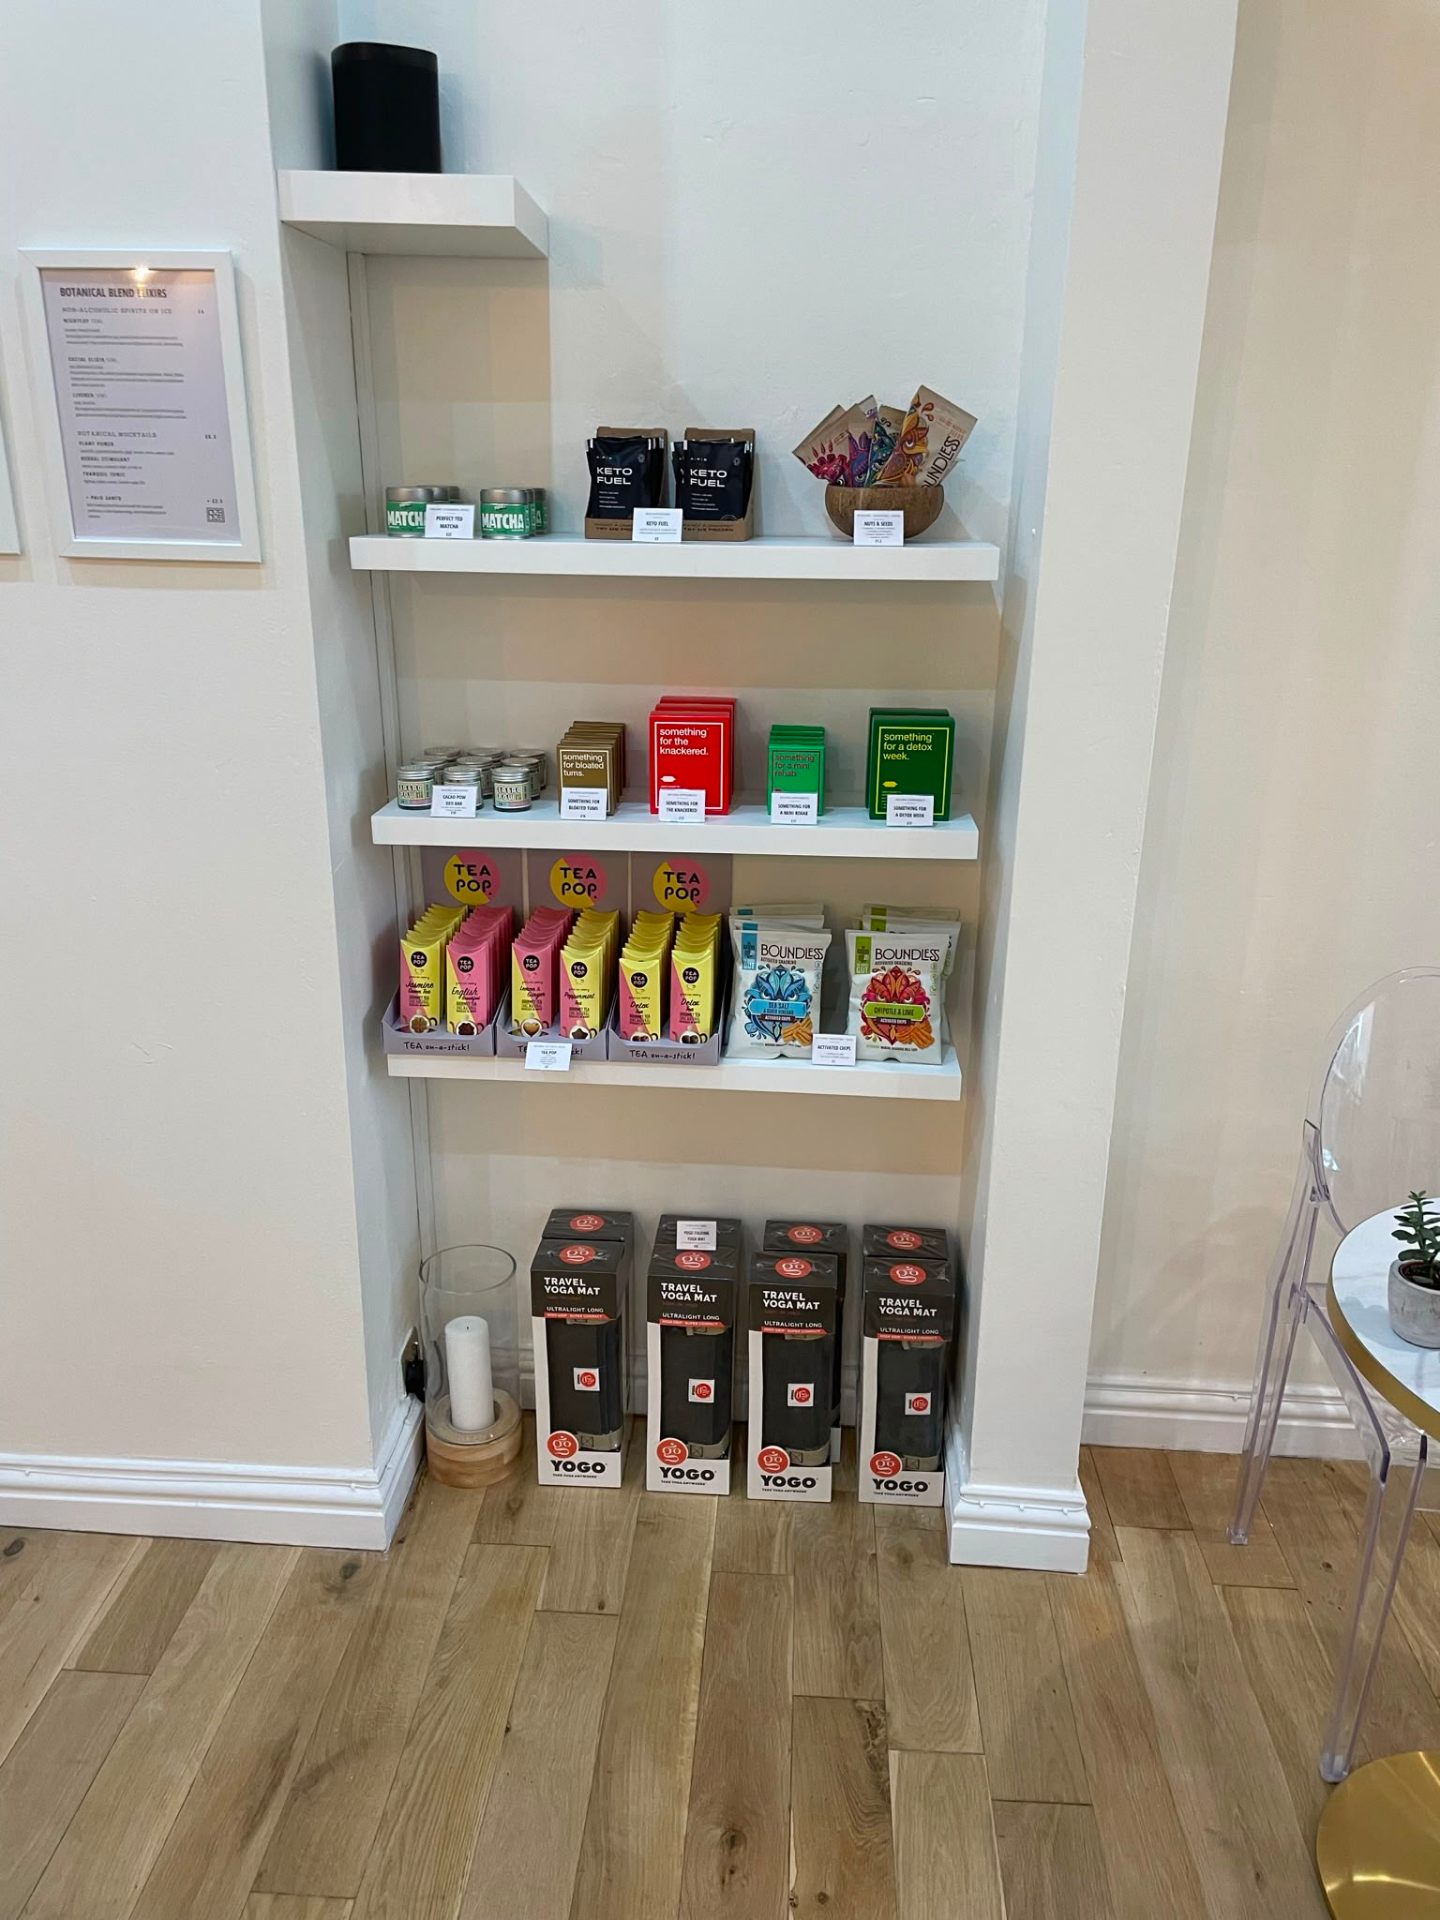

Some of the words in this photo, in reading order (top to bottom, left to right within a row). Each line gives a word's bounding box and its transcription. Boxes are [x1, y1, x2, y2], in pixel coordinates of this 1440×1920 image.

[60, 287, 106, 298] BOTANICAL
[108, 288, 135, 298] BLEND
[921, 436, 961, 488] UNDLESS
[596, 467, 633, 476] KETO
[690, 468, 727, 478] KETO
[596, 476, 631, 485] FUEL
[690, 478, 725, 488] FUEL
[387, 511, 426, 526] MATCH
[482, 513, 524, 529] MATCHA
[660, 728, 706, 738] something
[884, 732, 932, 742] something
[659, 737, 671, 746] for
[674, 738, 689, 746] the
[883, 742, 896, 751] for
[906, 742, 933, 751] detox
[660, 746, 709, 756] knackered.
[883, 752, 910, 760] week.
[563, 753, 603, 763] something
[562, 761, 574, 769] for
[575, 761, 605, 770] bloated
[563, 769, 585, 777] tums.
[453, 864, 491, 876] TEA
[560, 867, 597, 879] TEA
[663, 871, 700, 884] TEA
[760, 943, 824, 960] BOUNDLESS
[875, 948, 940, 962] BOUNDLESS
[451, 986, 478, 1000] English
[404, 1041, 422, 1050] TEA
[425, 1042, 470, 1051] on-a-stick!
[629, 1050, 648, 1058] TEA
[651, 1051, 696, 1060] on-a-stick!
[544, 1277, 586, 1287] TRAVEL
[544, 1286, 574, 1294] YOGA
[577, 1286, 600, 1296] MAT
[661, 1282, 703, 1293] TRAVEL
[661, 1291, 691, 1301] YOGA
[694, 1293, 718, 1303] MAT
[763, 1290, 806, 1301] TRAVEL
[763, 1300, 794, 1309] YOGA
[796, 1301, 820, 1310] MAT
[879, 1297, 923, 1308] TRAVEL
[662, 1312, 701, 1320] ULTRALIGHT
[879, 1306, 910, 1316] YOGA
[913, 1308, 937, 1317] MAT
[764, 1320, 803, 1328] ULTRALIGHT
[880, 1327, 919, 1335] ULTRALIGHT
[551, 1460, 606, 1473] YOGO
[660, 1467, 715, 1480] YOGO
[761, 1475, 817, 1488] YOGO
[872, 1478, 929, 1492] YOGO
